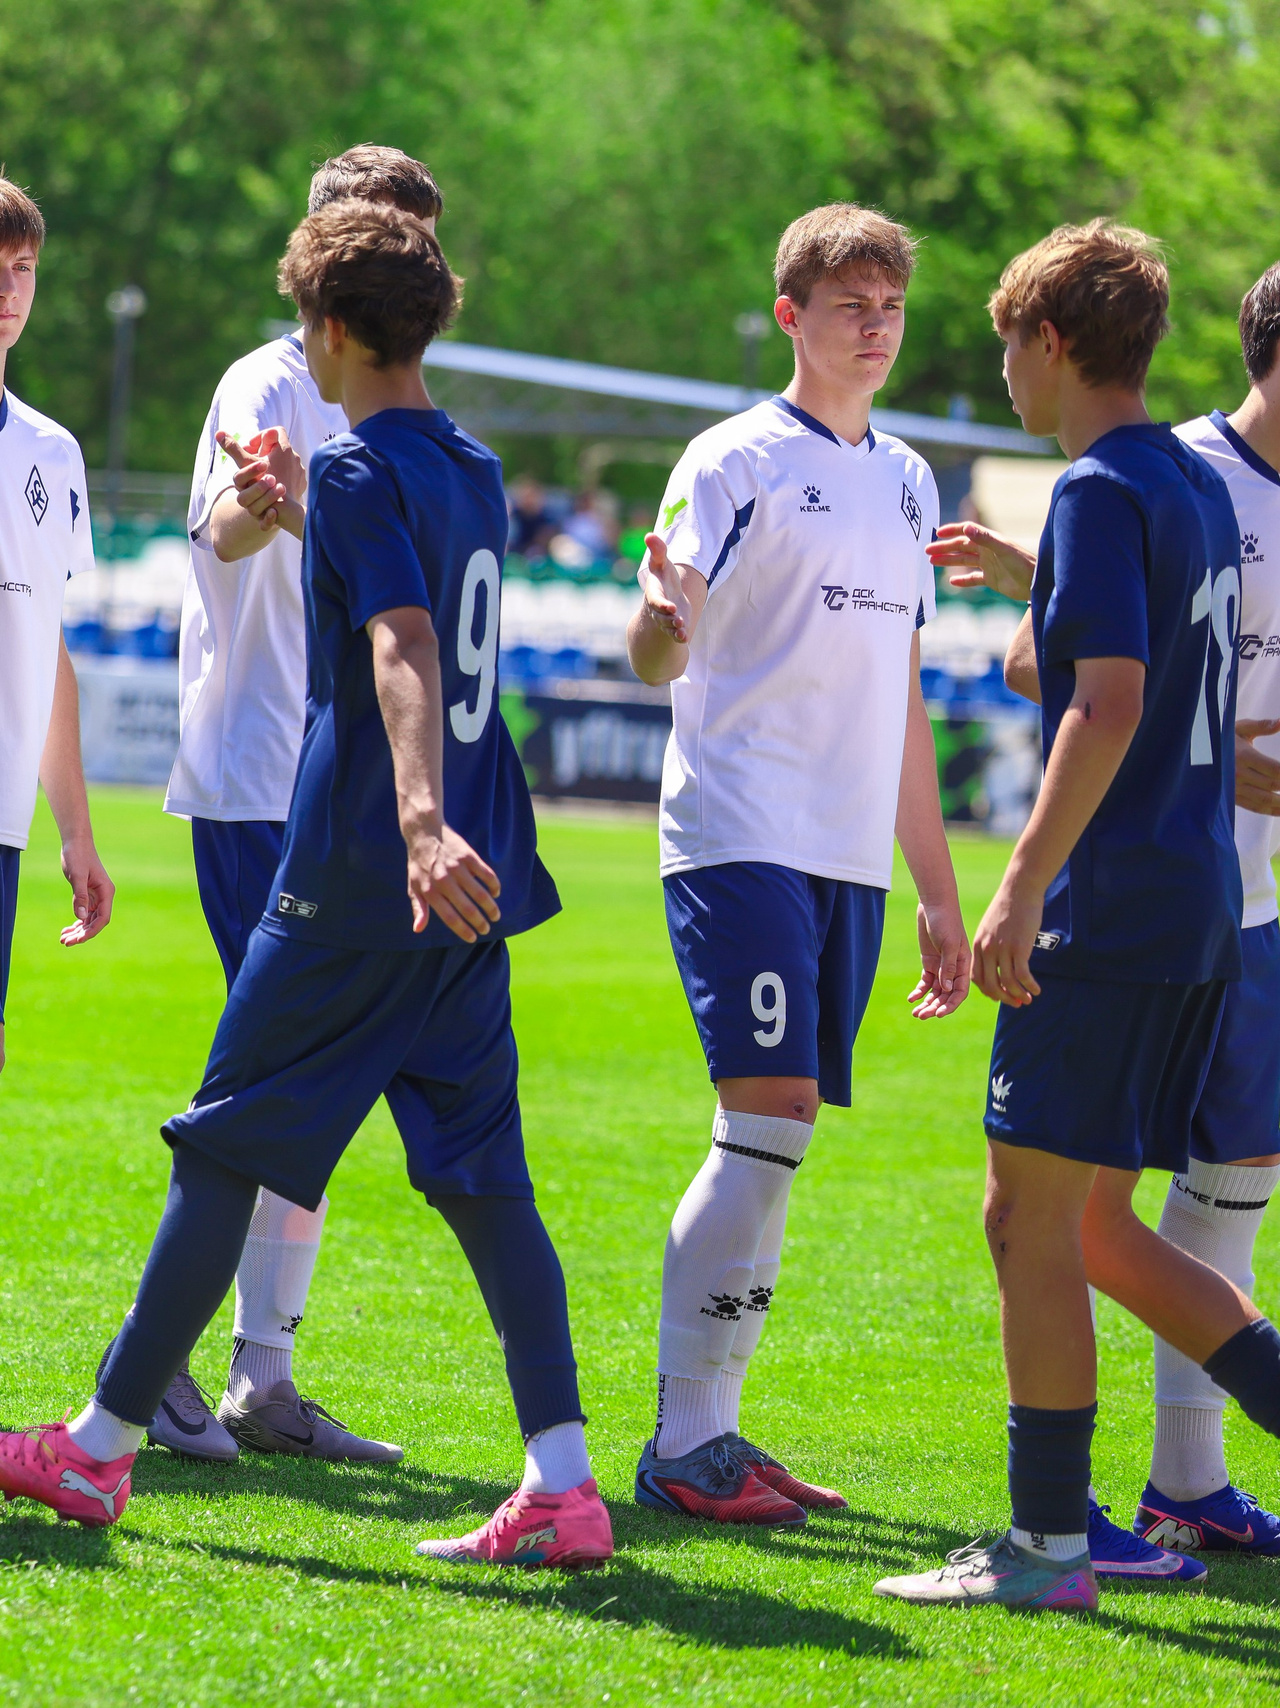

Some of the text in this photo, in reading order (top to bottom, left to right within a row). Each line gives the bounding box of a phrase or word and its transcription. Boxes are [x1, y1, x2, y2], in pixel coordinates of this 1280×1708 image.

[799, 505, 832, 513] KELME
[1241, 554, 1265, 564] ELME
[449, 548, 500, 744] 9
[750, 971, 787, 1048] 9
[1172, 1174, 1211, 1206] ELME
